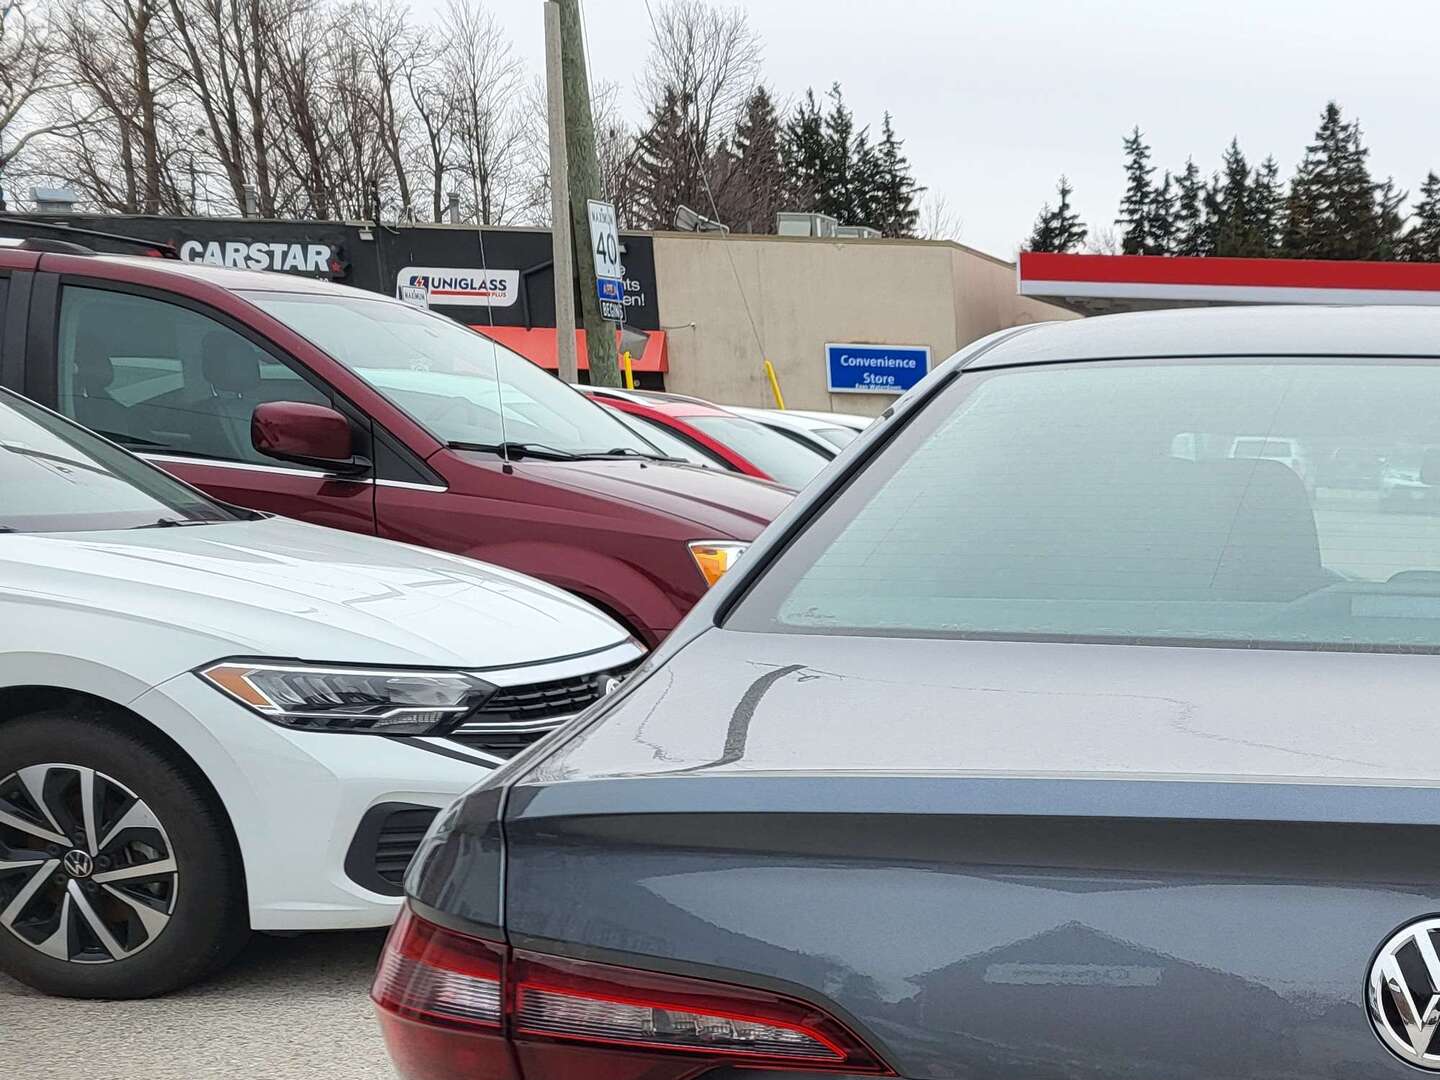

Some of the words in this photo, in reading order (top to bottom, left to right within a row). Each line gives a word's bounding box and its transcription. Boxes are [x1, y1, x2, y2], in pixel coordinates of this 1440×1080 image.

[597, 232, 617, 265] 40
[180, 240, 331, 272] CARSTAR
[431, 277, 507, 291] UNIGLASS
[840, 355, 917, 368] Convenience
[863, 372, 895, 384] Store
